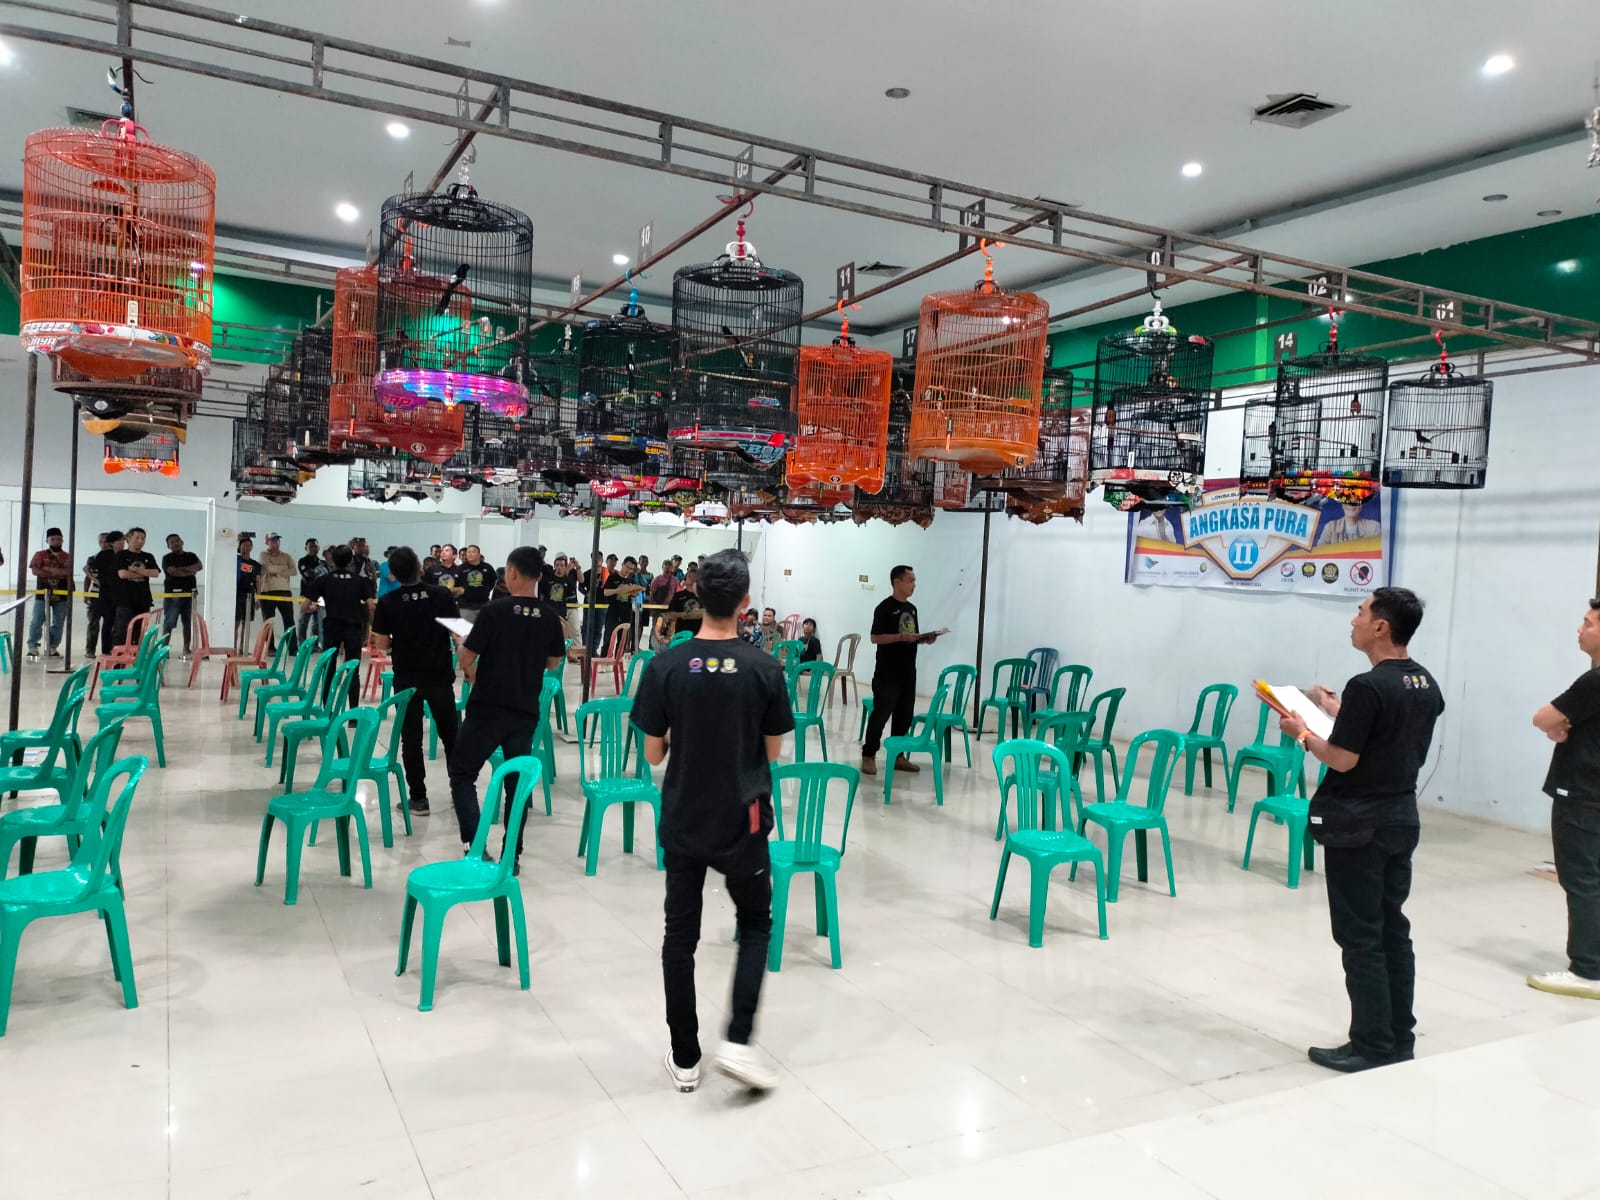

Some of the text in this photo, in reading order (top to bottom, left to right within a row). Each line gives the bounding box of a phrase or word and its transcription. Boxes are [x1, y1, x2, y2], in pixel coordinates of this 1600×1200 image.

[640, 225, 651, 247] 10
[839, 267, 851, 287] 11
[1308, 276, 1328, 297] 02
[1436, 300, 1455, 321] 01
[905, 328, 917, 345] 17
[1278, 331, 1294, 349] 14
[1189, 506, 1309, 538] ANGKASA PURA
[1233, 542, 1254, 565] II
